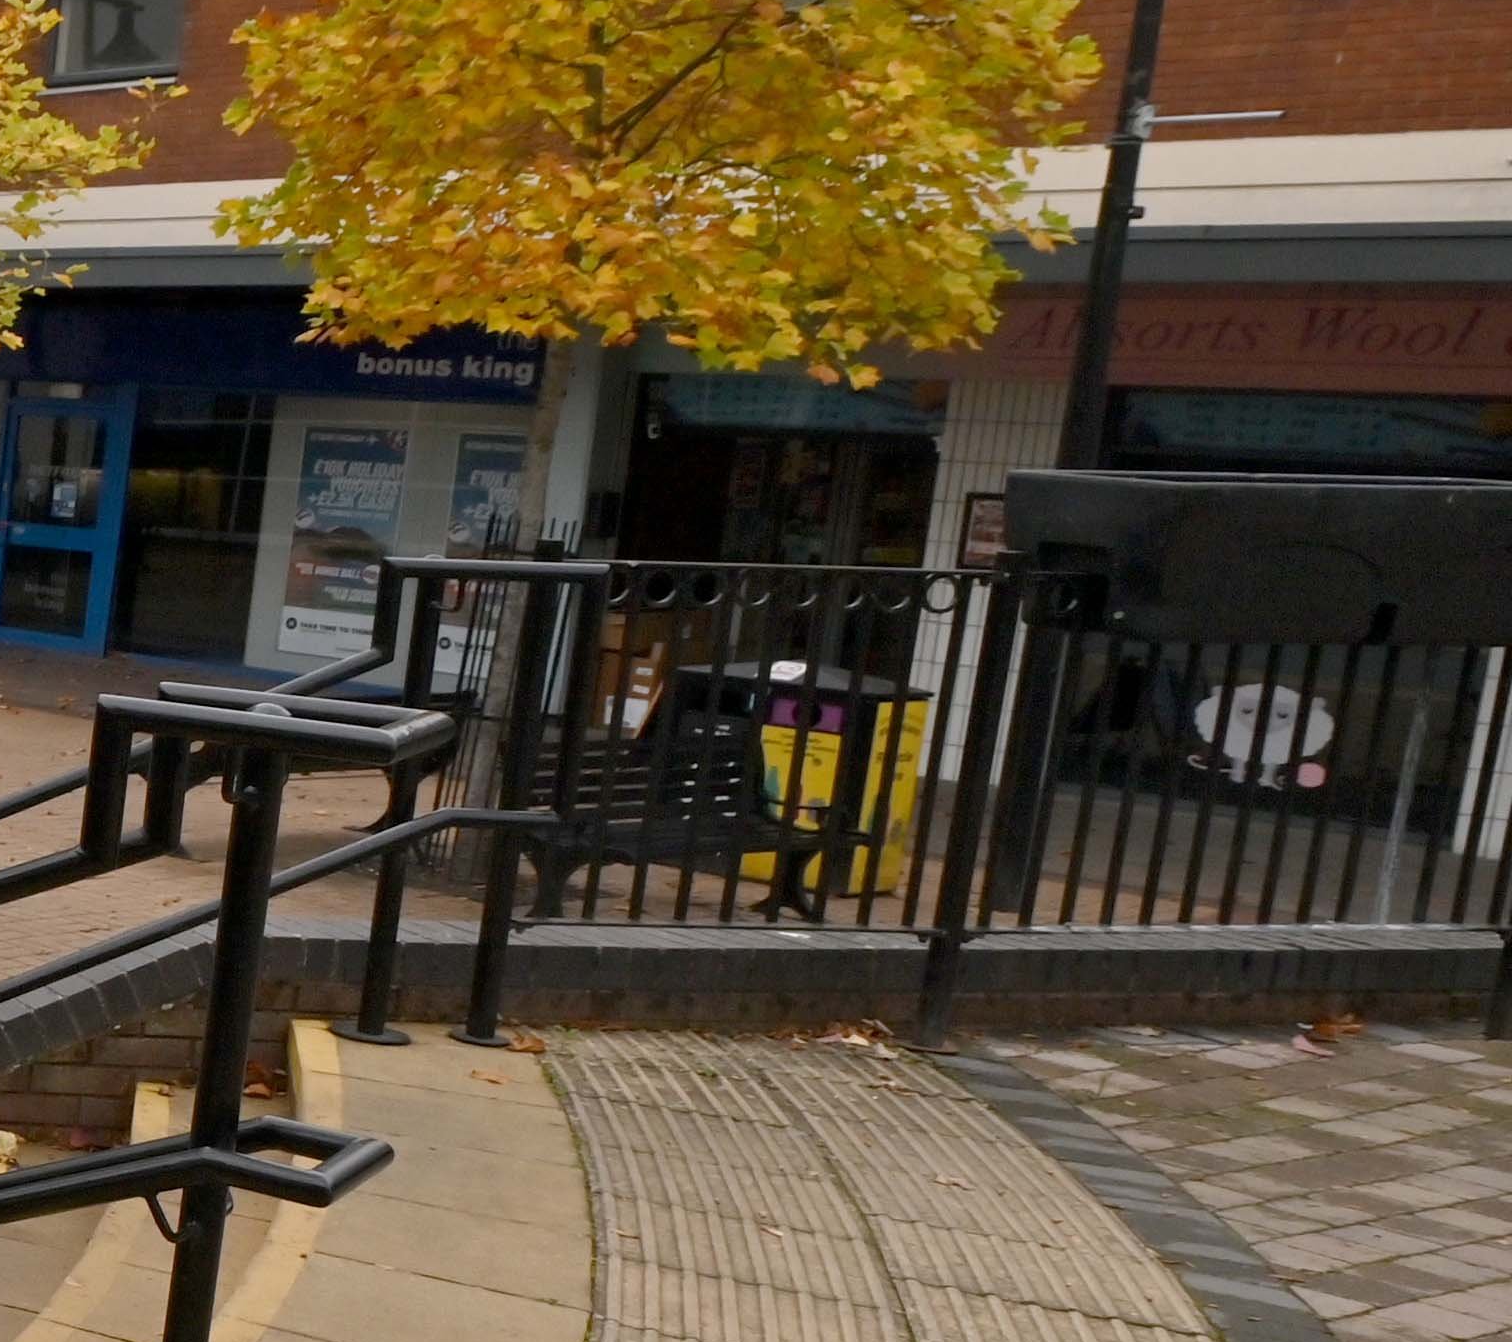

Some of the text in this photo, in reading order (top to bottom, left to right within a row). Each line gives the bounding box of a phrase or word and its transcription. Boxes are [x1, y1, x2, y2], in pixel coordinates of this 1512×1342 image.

[1009, 307, 1266, 352] Alsorts
[1297, 305, 1485, 358] Wool
[356, 351, 536, 386] bonus king
